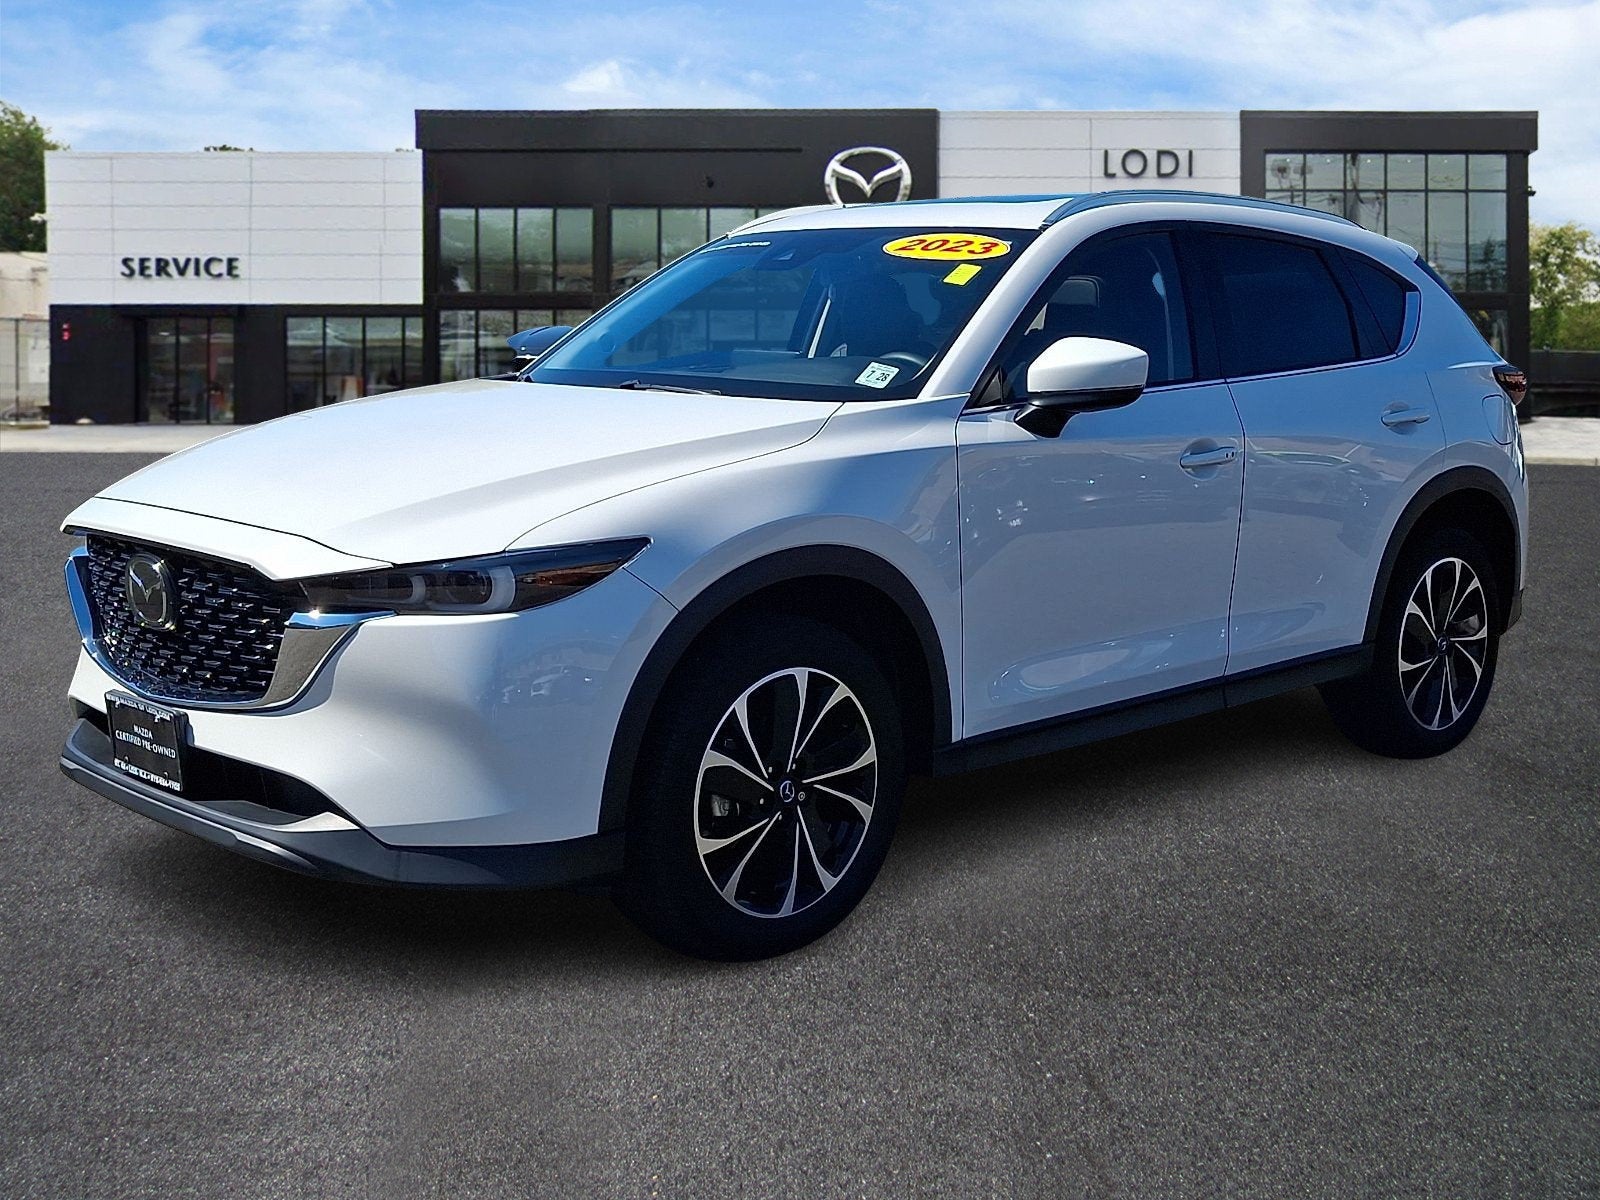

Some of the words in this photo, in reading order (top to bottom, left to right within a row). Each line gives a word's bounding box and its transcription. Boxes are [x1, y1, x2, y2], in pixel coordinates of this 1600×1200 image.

[1104, 149, 1193, 178] LODI
[893, 239, 999, 254] 2023
[120, 256, 240, 278] SERVICE
[133, 724, 153, 740] MAZDA
[115, 730, 142, 746] CERTIFIED
[142, 739, 176, 759] PRE-OWNED
